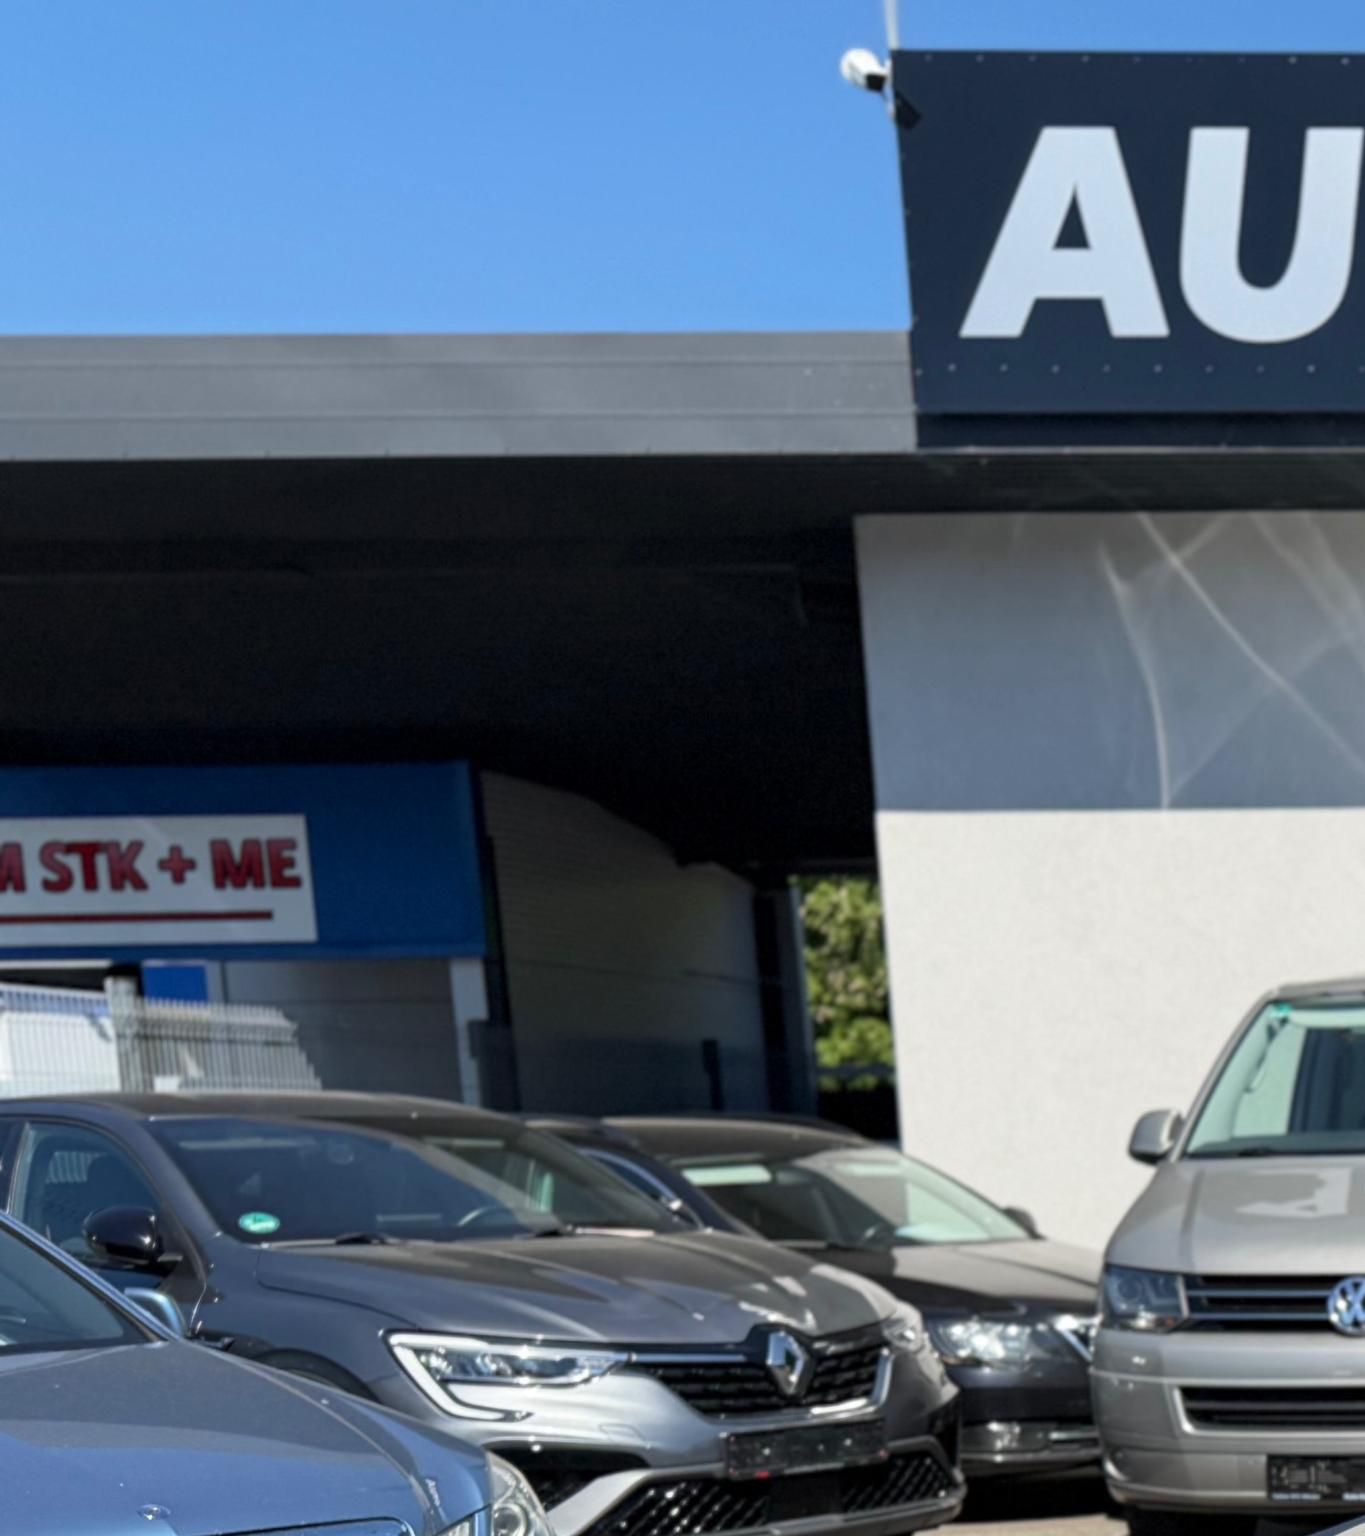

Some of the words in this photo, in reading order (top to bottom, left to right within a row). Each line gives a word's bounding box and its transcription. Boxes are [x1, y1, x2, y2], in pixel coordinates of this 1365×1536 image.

[40, 840, 148, 893] STK
[158, 844, 196, 885] +
[210, 838, 303, 889] ME
